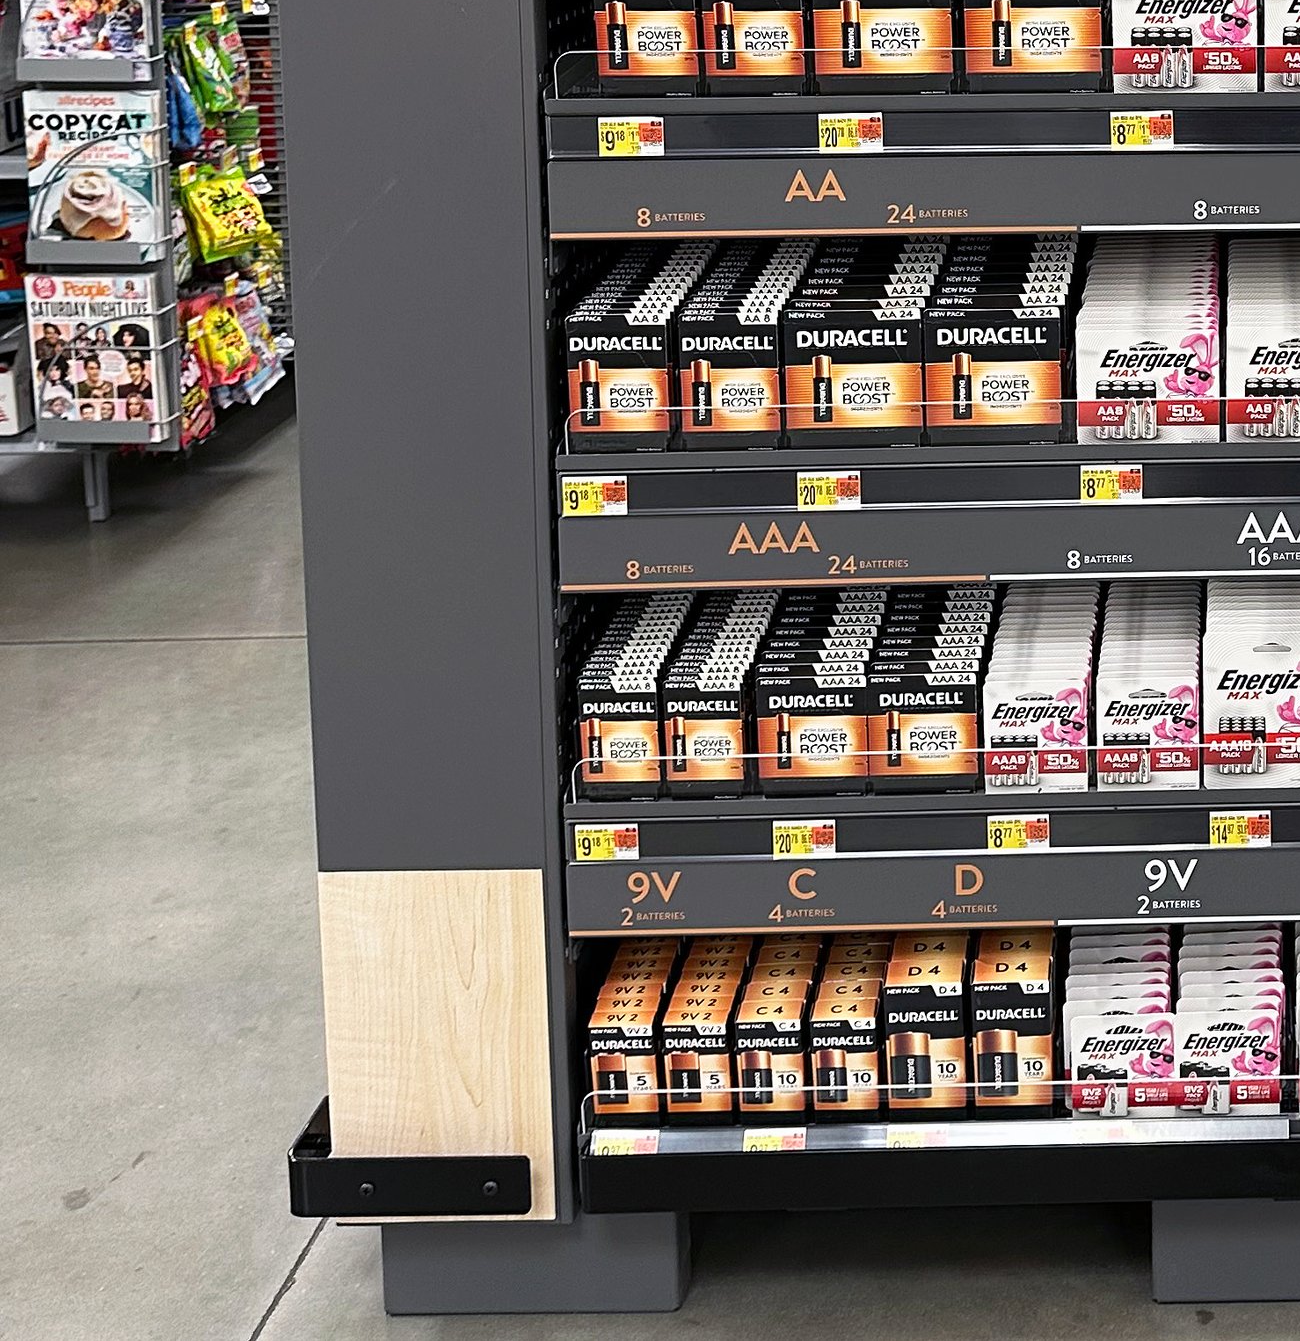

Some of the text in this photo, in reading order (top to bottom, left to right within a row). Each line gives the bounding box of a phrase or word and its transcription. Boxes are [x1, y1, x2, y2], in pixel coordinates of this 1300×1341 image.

[871, 27, 919, 38] POWER
[28, 114, 147, 131] COPYCAT
[784, 168, 847, 203] AA
[886, 203, 969, 224] 24 BATTERIES
[62, 281, 112, 299] People
[89, 302, 122, 317] NIGHT
[936, 327, 1047, 346] DURACELL
[727, 520, 821, 555] AAA
[827, 554, 909, 575] 24 BATTERIES
[1248, 546, 1271, 566] 16
[821, 676, 861, 687] AAA 24
[769, 694, 854, 710] DURACELL
[788, 867, 817, 900] C
[954, 864, 984, 896] D
[1144, 858, 1198, 893] 9V
[627, 871, 682, 904] 9V
[767, 903, 836, 923] 4 BATTERIES
[1137, 895, 1201, 915] 2 BATTERIES
[620, 907, 686, 927] 2 BATTERIES
[908, 965, 942, 977] D 4
[889, 1009, 958, 1024] DURACELL
[937, 1063, 956, 1074] 10
